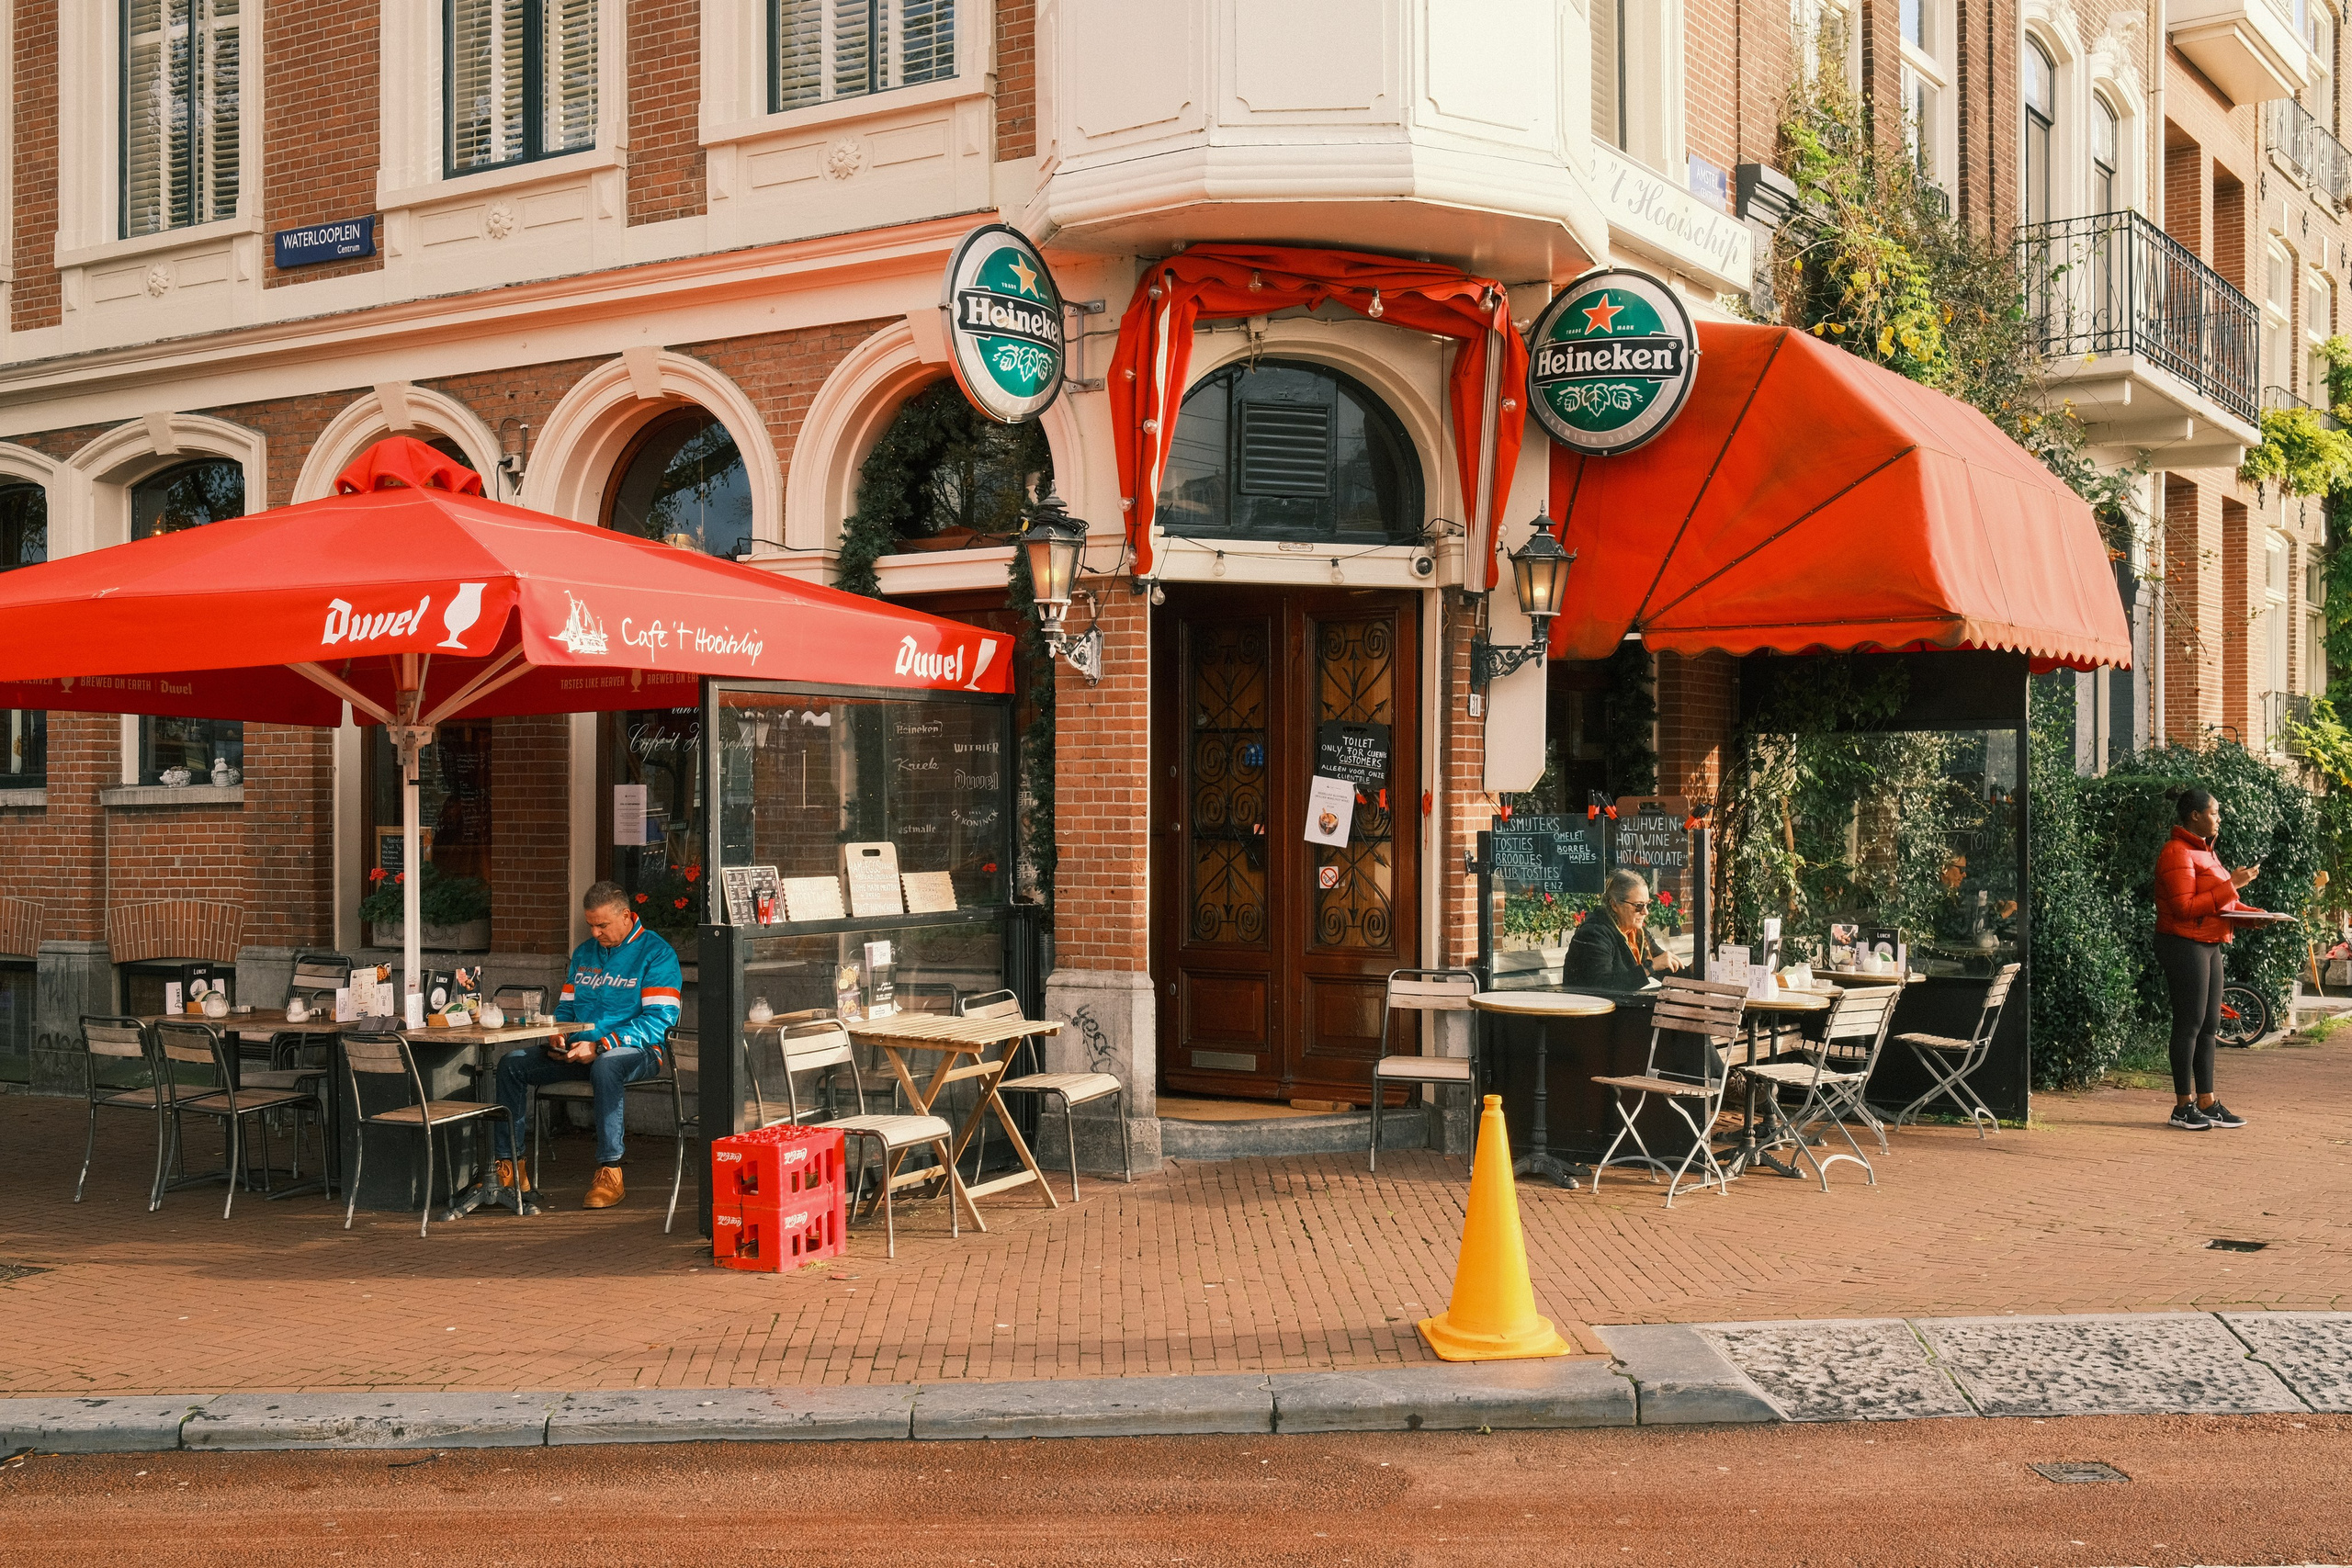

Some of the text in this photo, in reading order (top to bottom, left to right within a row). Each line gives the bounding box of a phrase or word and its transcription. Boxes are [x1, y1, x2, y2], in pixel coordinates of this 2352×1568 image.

[1696, 164, 1719, 191] AMSTEL
[282, 223, 360, 250] WATERLOOPLEIN
[336, 244, 360, 254] Centrum
[1001, 282, 1017, 290] TRADE
[1543, 406, 1663, 444] PREMIUM QUALITY
[322, 595, 431, 645] Duvel
[895, 635, 965, 682] Duvel
[81, 676, 113, 689] BREWED
[115, 679, 126, 689] ON
[128, 680, 152, 691] EARTH
[160, 680, 193, 695] Duvel
[560, 678, 584, 690] TASTES
[584, 677, 599, 689] LIKE
[600, 675, 626, 688] HEAVEN
[647, 673, 674, 685] BREWED
[675, 672, 685, 683] ON
[1472, 695, 1478, 715] 31
[896, 724, 939, 734] Heineken
[954, 742, 999, 754] WITBIER
[1342, 735, 1374, 748] TOILET
[1321, 743, 1343, 757] ONLY
[1347, 746, 1363, 757] FOR
[892, 757, 940, 772] Kriek
[1339, 754, 1382, 768] CUSTOMERS
[954, 768, 999, 790] Duvel
[1321, 764, 1385, 780] ALLEEN VOOR ONZE
[1337, 773, 1371, 784] CLIENTELE
[951, 808, 999, 827] DE KONINCK
[1554, 830, 1585, 840] OMELET
[1616, 832, 1635, 846] HOT
[1640, 833, 1670, 846] WINE
[1494, 837, 1533, 851] TOSTIES
[1556, 844, 1591, 853] BORREL
[1495, 853, 1543, 865] BROODJES
[1568, 852, 1597, 863] HAPJES
[1616, 850, 1683, 866] HOT CHOCOLATE
[1494, 866, 1560, 878] CLUB TOSTIES
[435, 976, 448, 984] LUNCH
[574, 972, 638, 990] Dolphins
